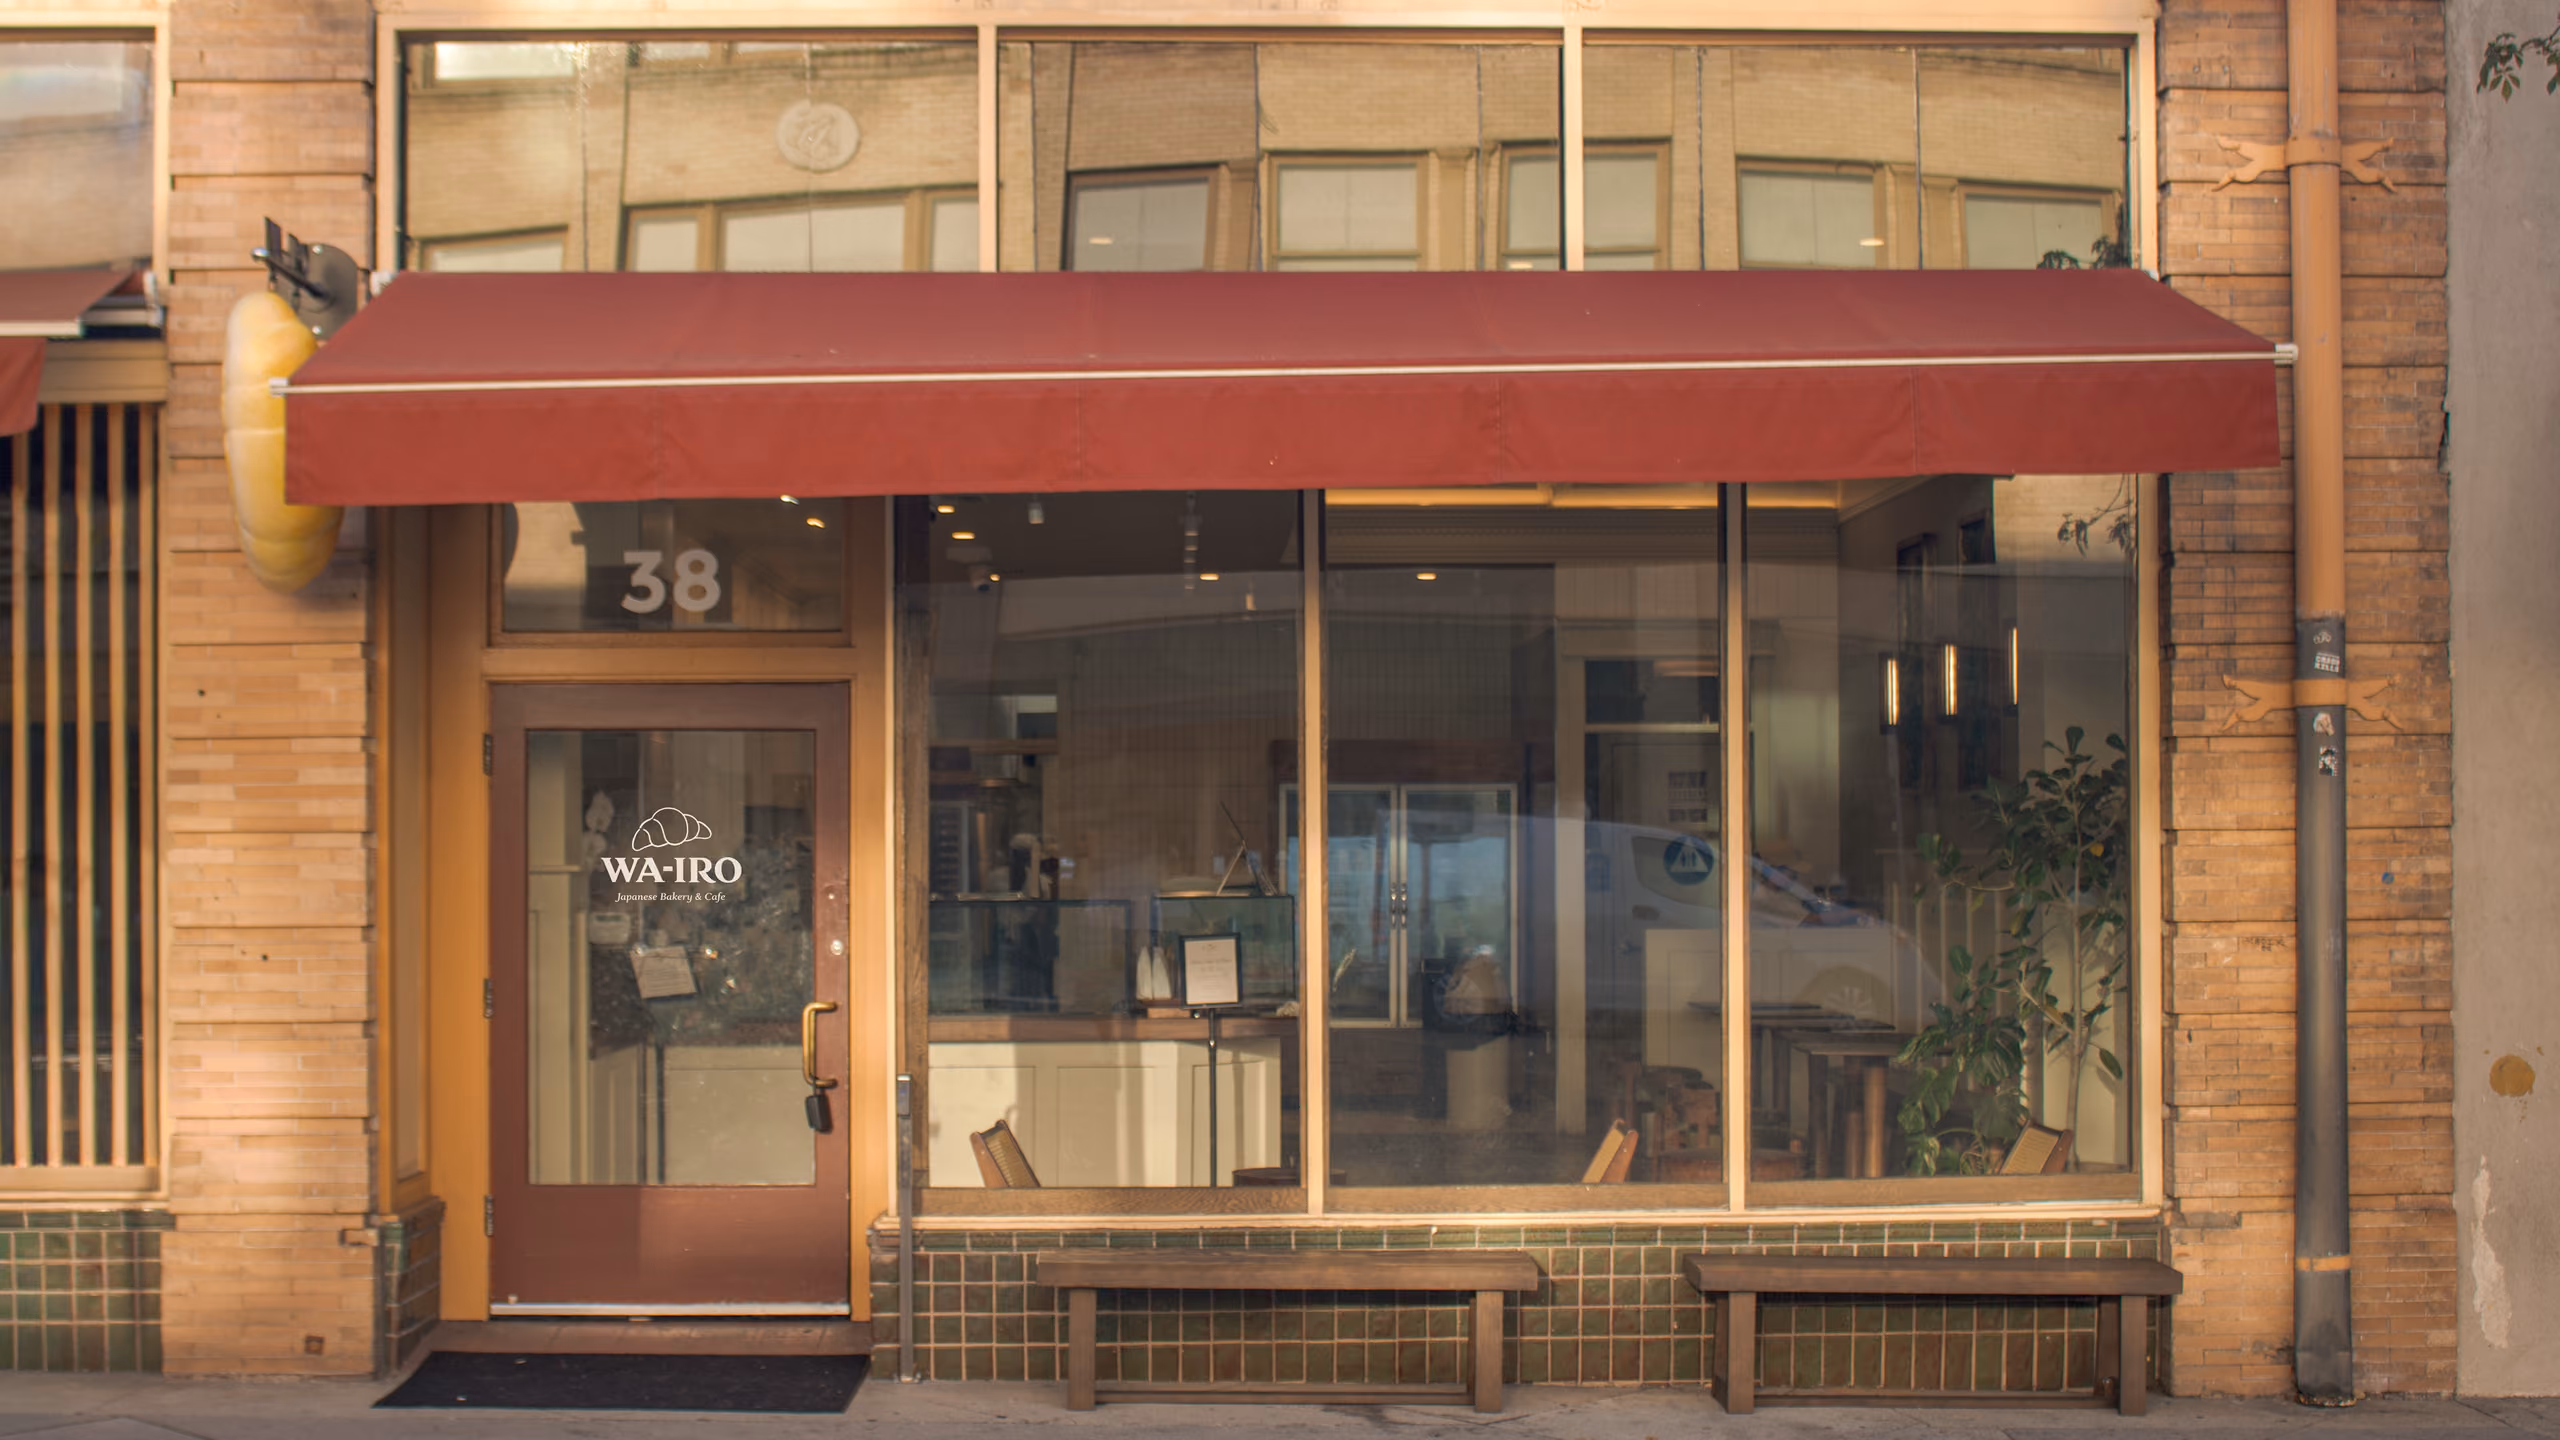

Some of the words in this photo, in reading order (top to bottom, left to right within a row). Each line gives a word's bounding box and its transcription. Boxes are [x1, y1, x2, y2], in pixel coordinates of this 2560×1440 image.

[621, 550, 721, 614] 38
[601, 857, 742, 883] WA-IRO
[615, 893, 658, 903] Japanese
[660, 892, 693, 903] Bakery
[694, 893, 702, 901] &
[704, 892, 726, 903] Cafe
